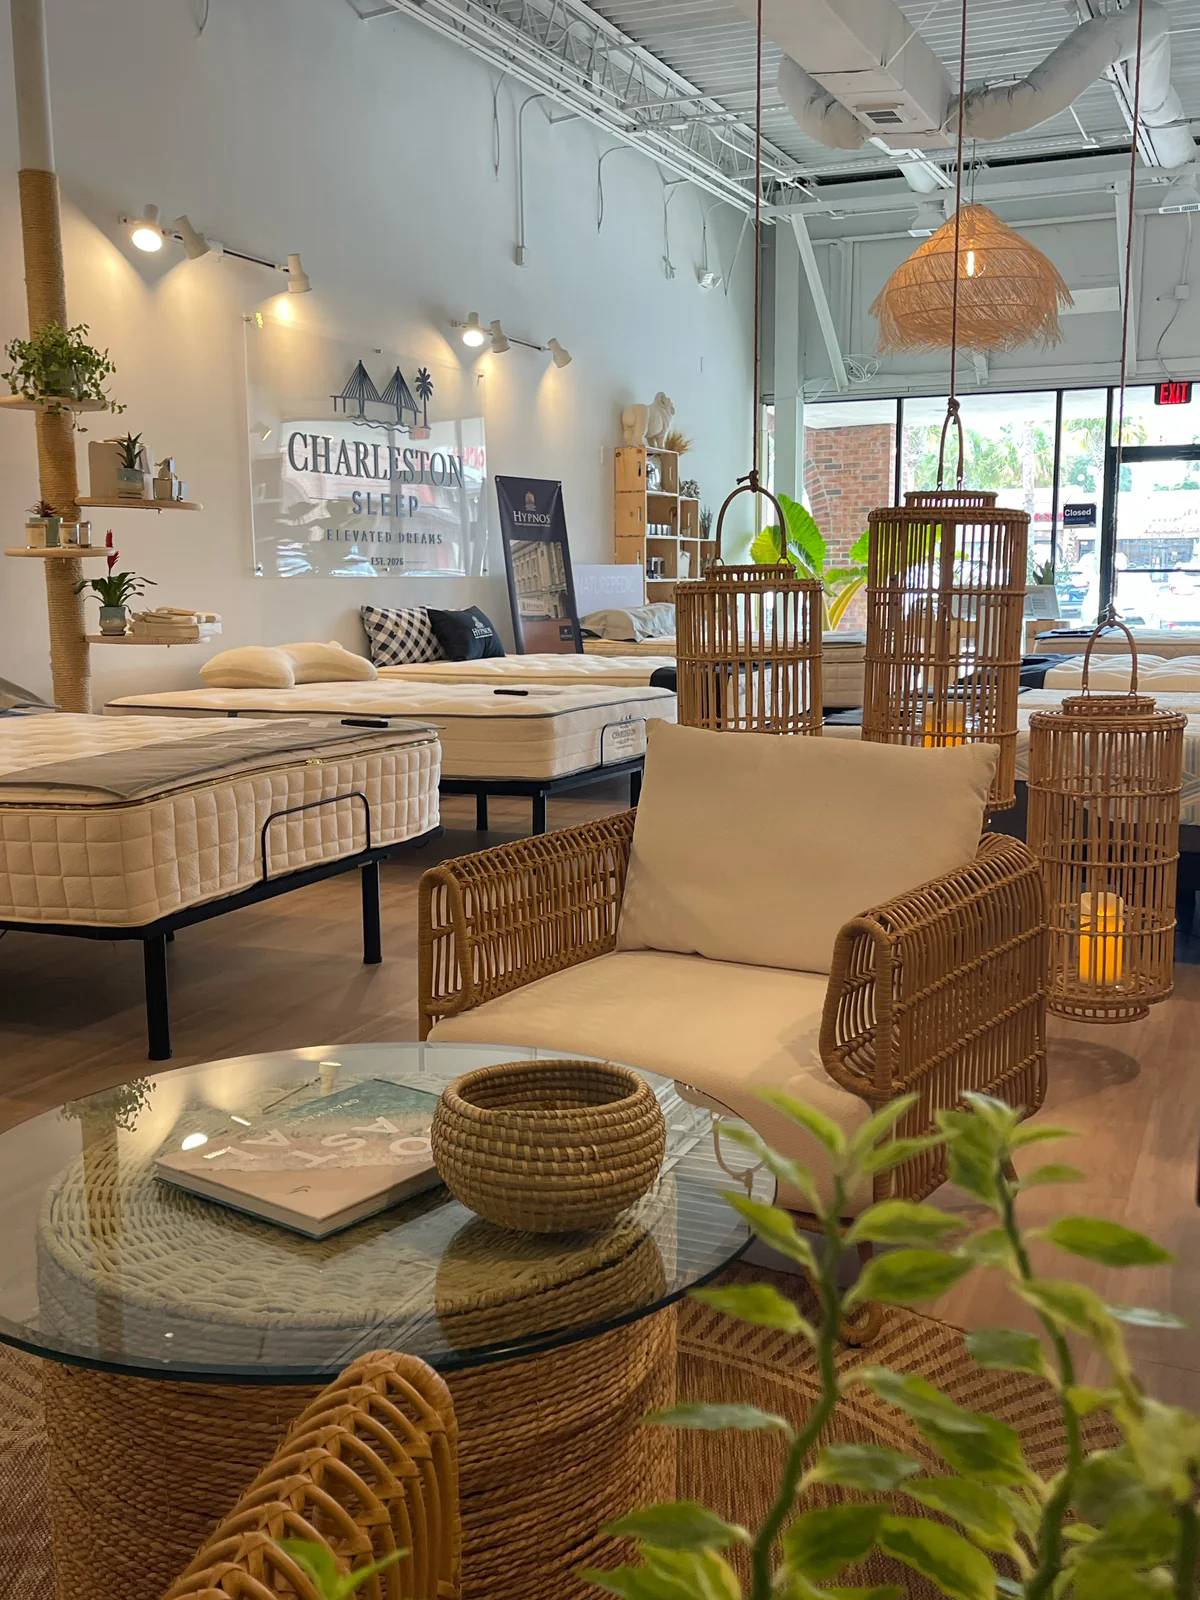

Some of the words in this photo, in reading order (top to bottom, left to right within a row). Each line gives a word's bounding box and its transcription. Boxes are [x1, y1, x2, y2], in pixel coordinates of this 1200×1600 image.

[1160, 382, 1188, 404] EXIT
[288, 431, 466, 488] CHARLESTON
[352, 490, 419, 518] SLEEP
[1064, 508, 1092, 517] Closed
[513, 510, 551, 524] HYPNOS
[326, 528, 393, 543] ELEVATED
[398, 531, 443, 545] DREAMS
[371, 557, 386, 566] EST.
